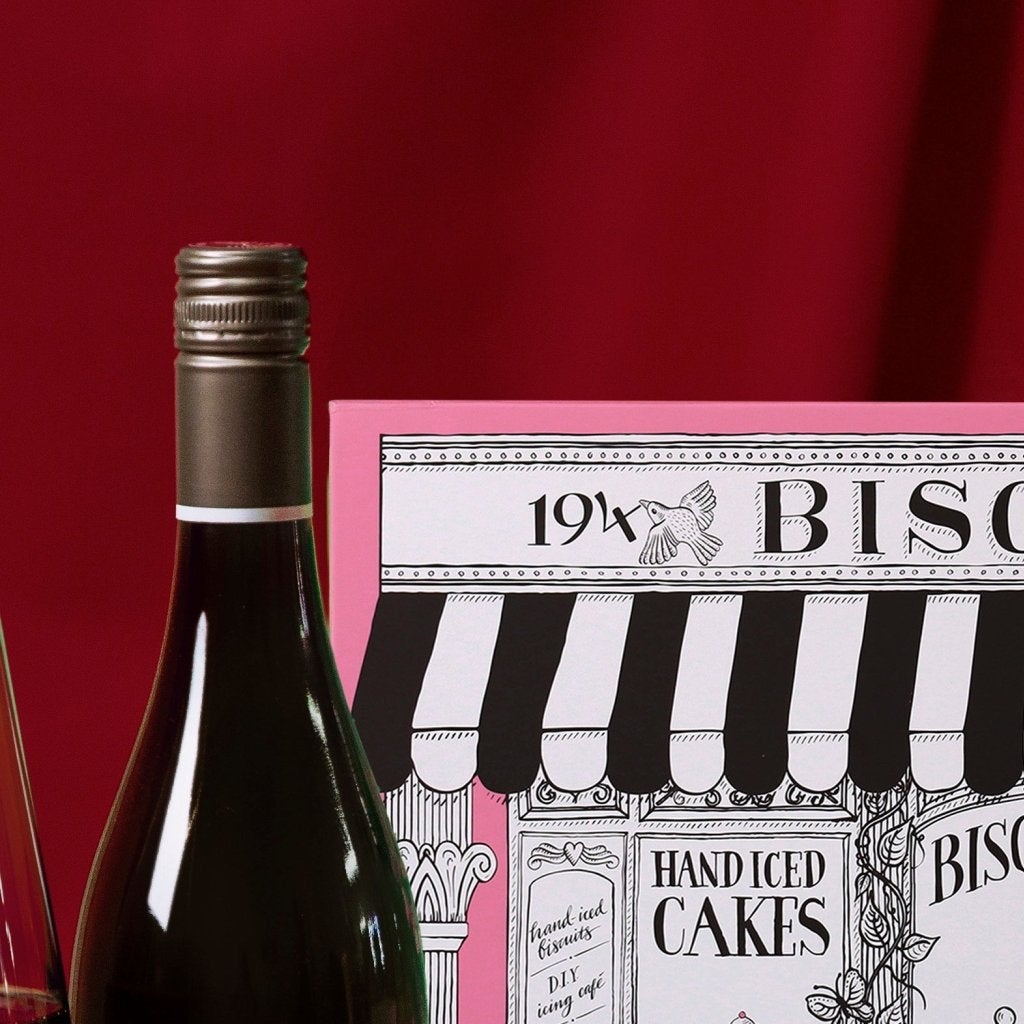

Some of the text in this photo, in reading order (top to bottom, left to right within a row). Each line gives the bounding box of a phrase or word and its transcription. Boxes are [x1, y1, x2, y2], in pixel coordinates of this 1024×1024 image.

[650, 849, 826, 888] HAND ICED
[530, 898, 607, 943] hand-iced
[537, 925, 602, 961] biscuits
[652, 895, 831, 957] CAKES
[537, 971, 606, 1018] icing café
